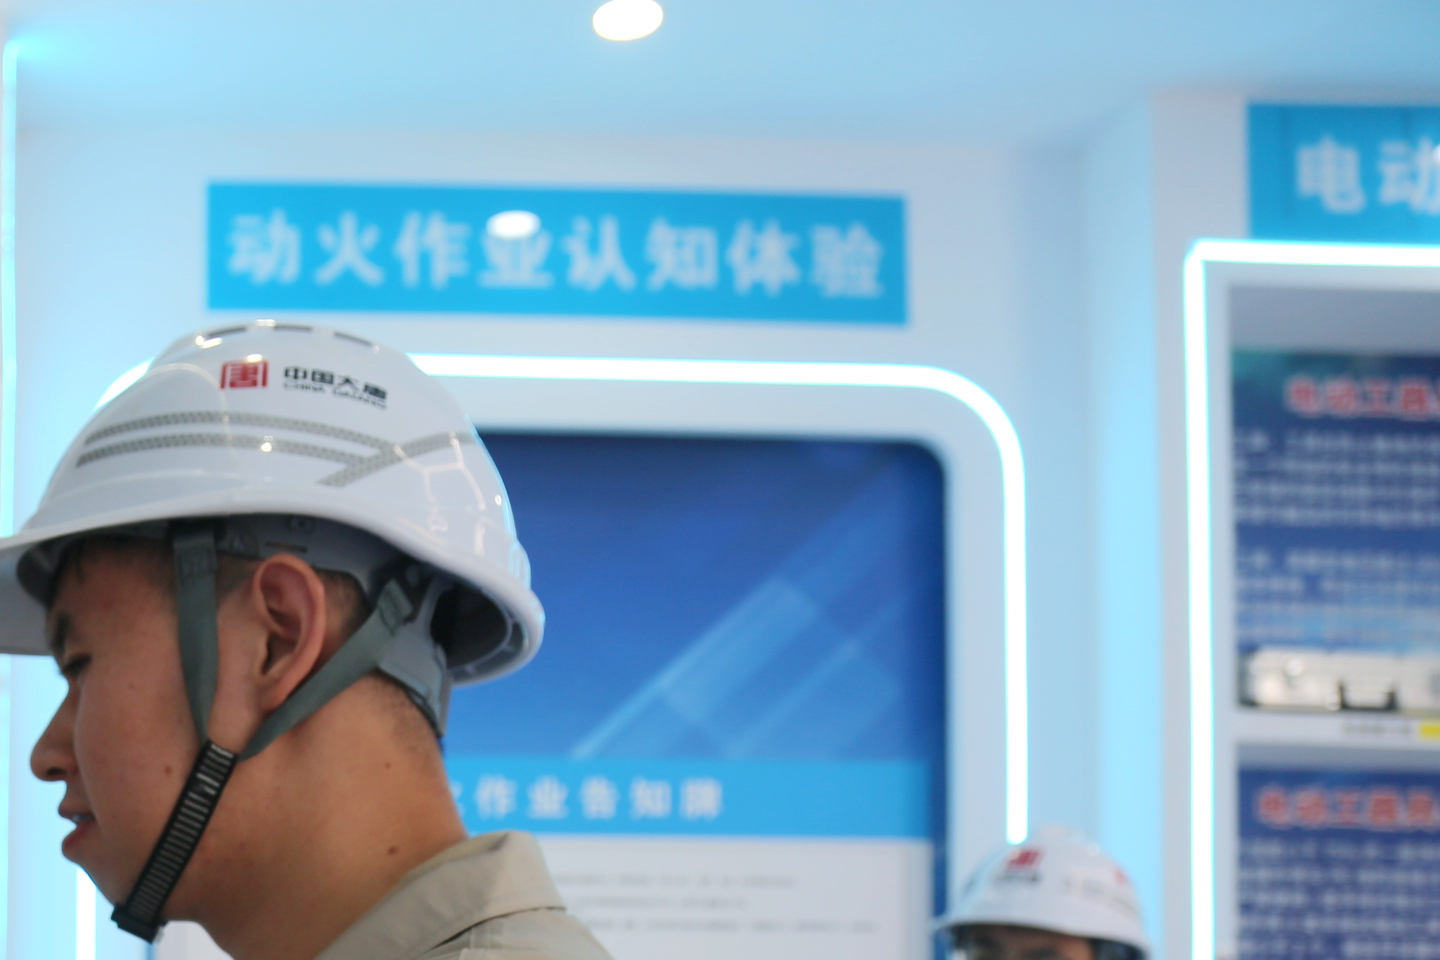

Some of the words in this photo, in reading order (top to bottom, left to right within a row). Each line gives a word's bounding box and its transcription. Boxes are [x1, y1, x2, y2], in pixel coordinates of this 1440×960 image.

[227, 208, 884, 298] 动火作业认知体验
[283, 366, 388, 400] 中国大唐
[450, 774, 724, 820] 作业告知牌
